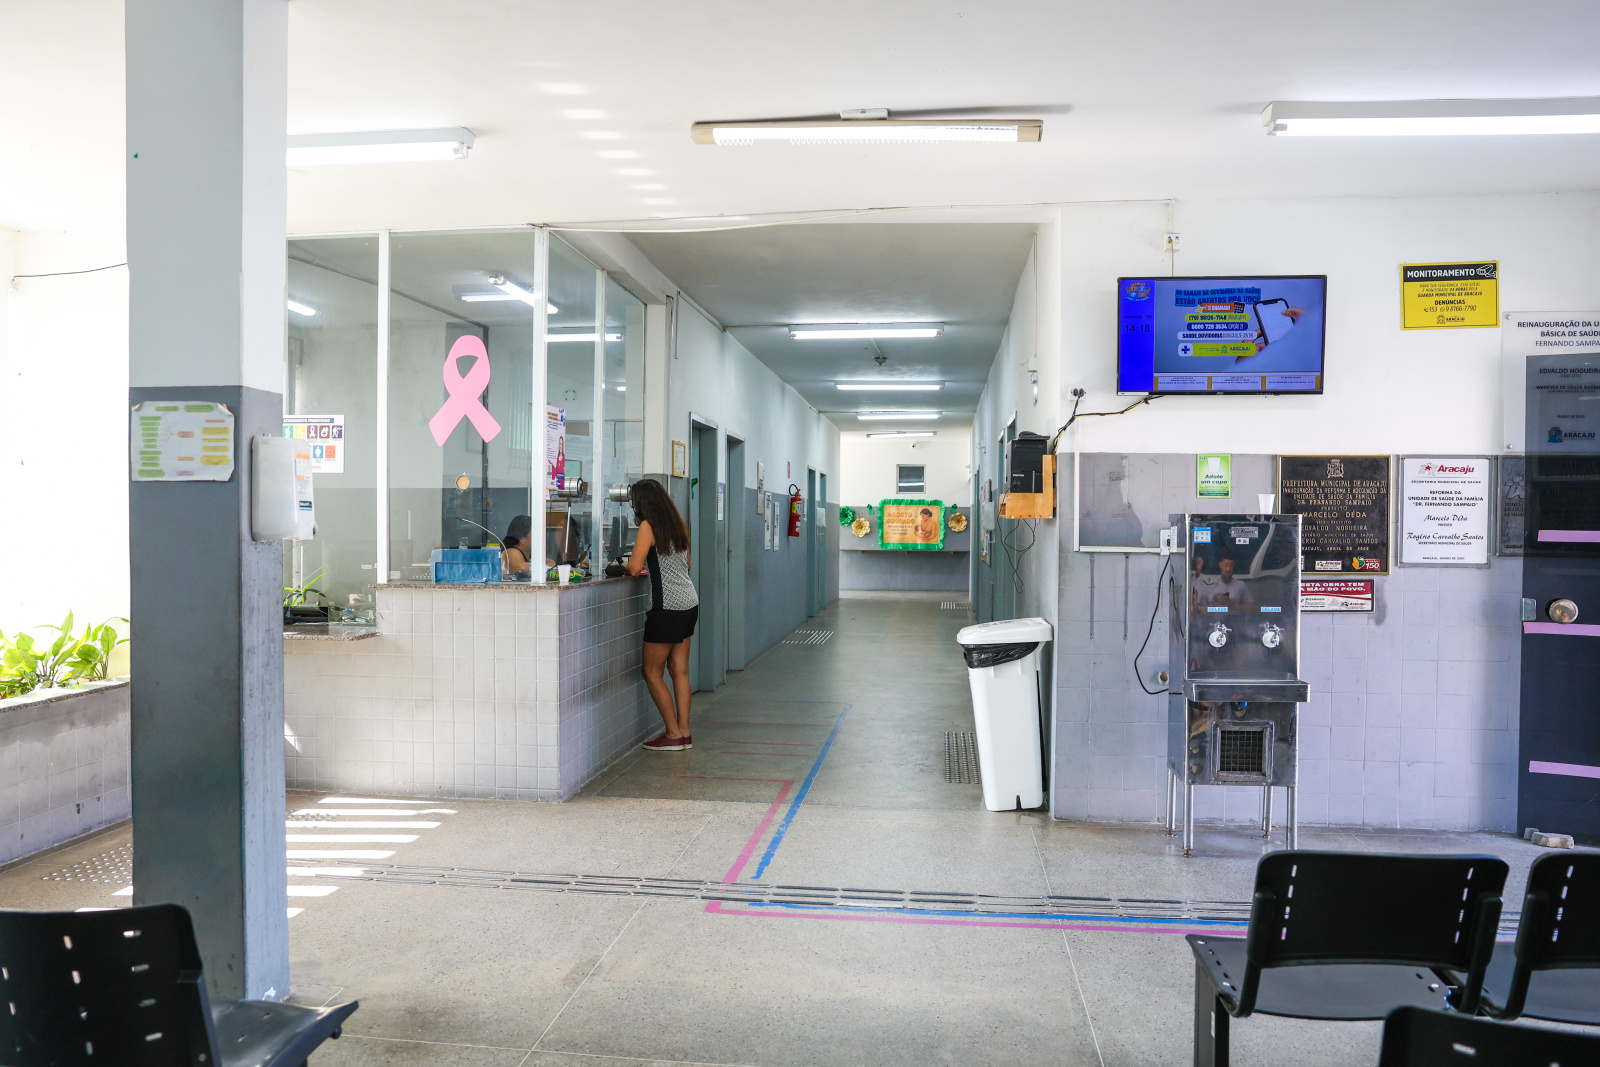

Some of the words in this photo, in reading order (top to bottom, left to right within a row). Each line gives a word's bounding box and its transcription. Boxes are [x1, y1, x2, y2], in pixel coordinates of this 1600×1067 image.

[1407, 268, 1475, 278] MONITORAMENTO
[1176, 296, 1196, 305] ESTÃO
[1243, 295, 1260, 303] VOCÊ
[1518, 320, 1580, 328] REINAUGURAÇÃO
[1437, 465, 1475, 474] Aracaju
[1346, 510, 1367, 518] DÉDA
[1407, 532, 1430, 541] Rogério
